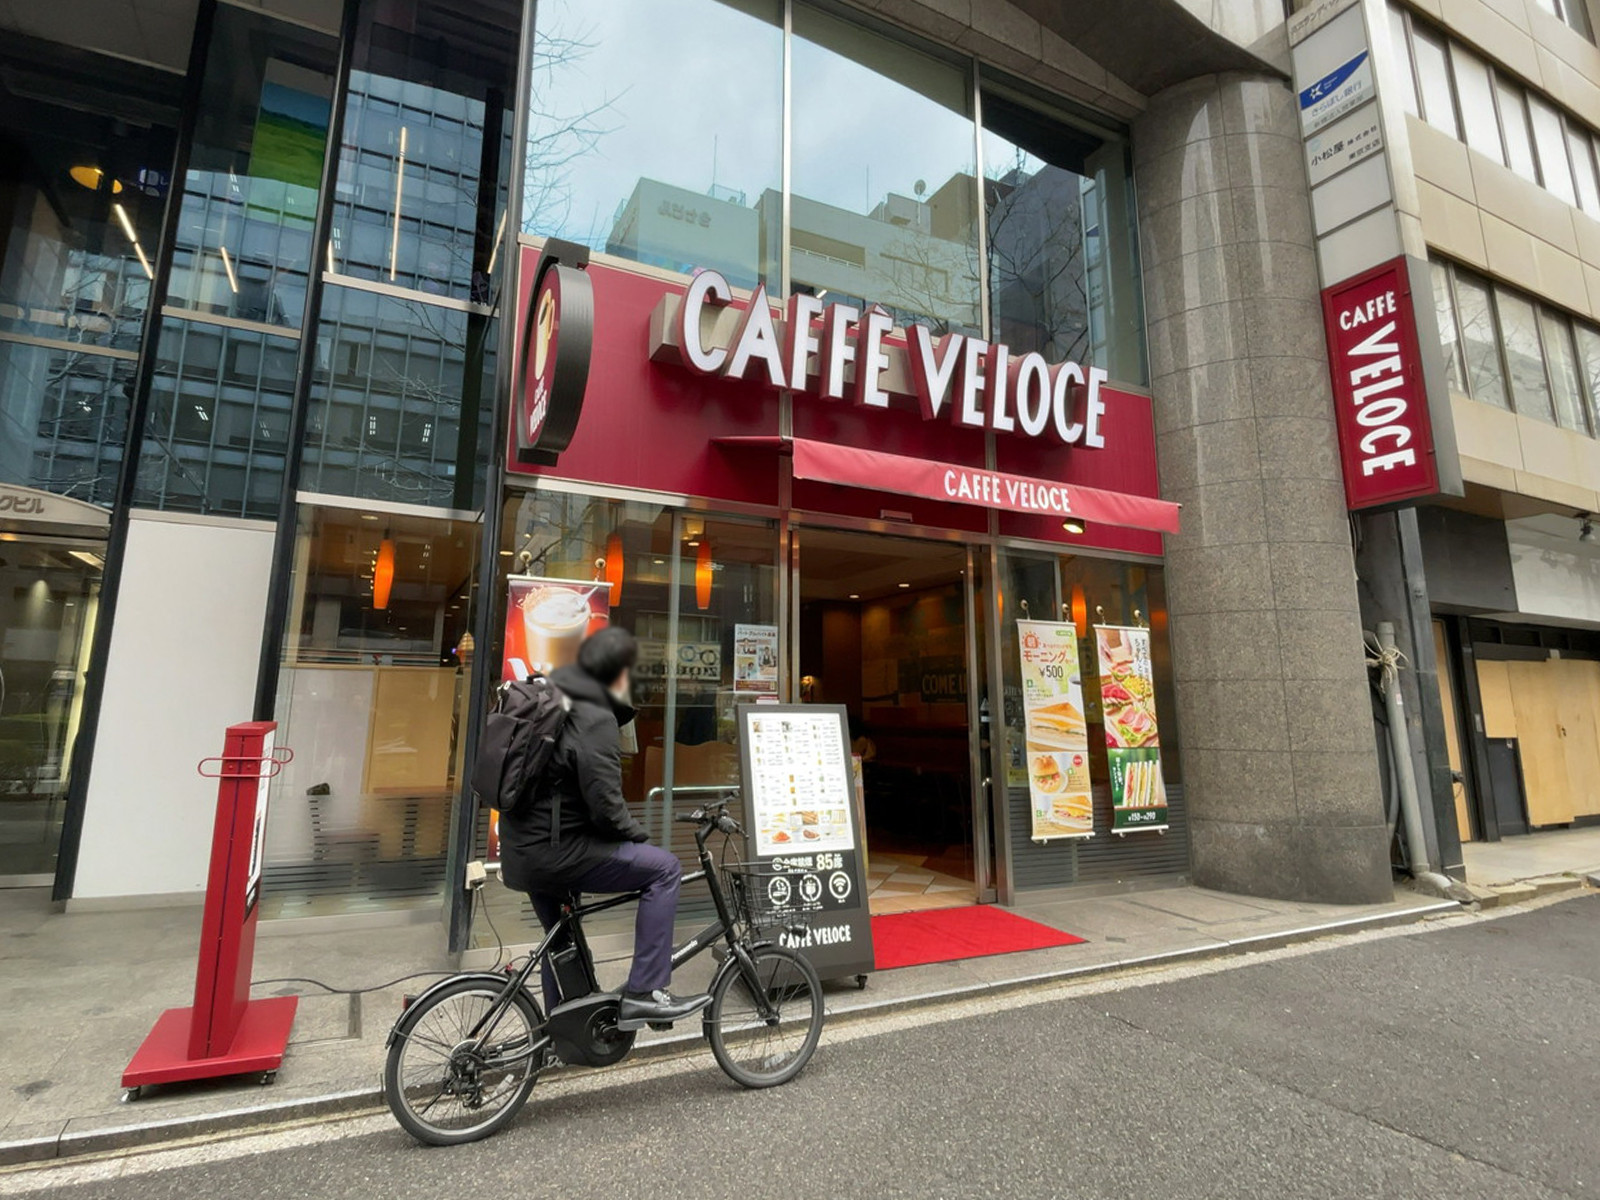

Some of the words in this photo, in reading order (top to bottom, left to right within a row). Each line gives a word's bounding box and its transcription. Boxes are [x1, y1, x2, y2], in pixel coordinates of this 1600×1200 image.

[1311, 141, 1345, 167] 小松屋
[914, 323, 1109, 450] VELOCE
[1347, 320, 1417, 477] VELOCE
[1005, 478, 1072, 513] VELOCE
[1023, 649, 1067, 664] モーニング
[1038, 664, 1064, 679] ¥500
[813, 924, 852, 945] VELOCE
